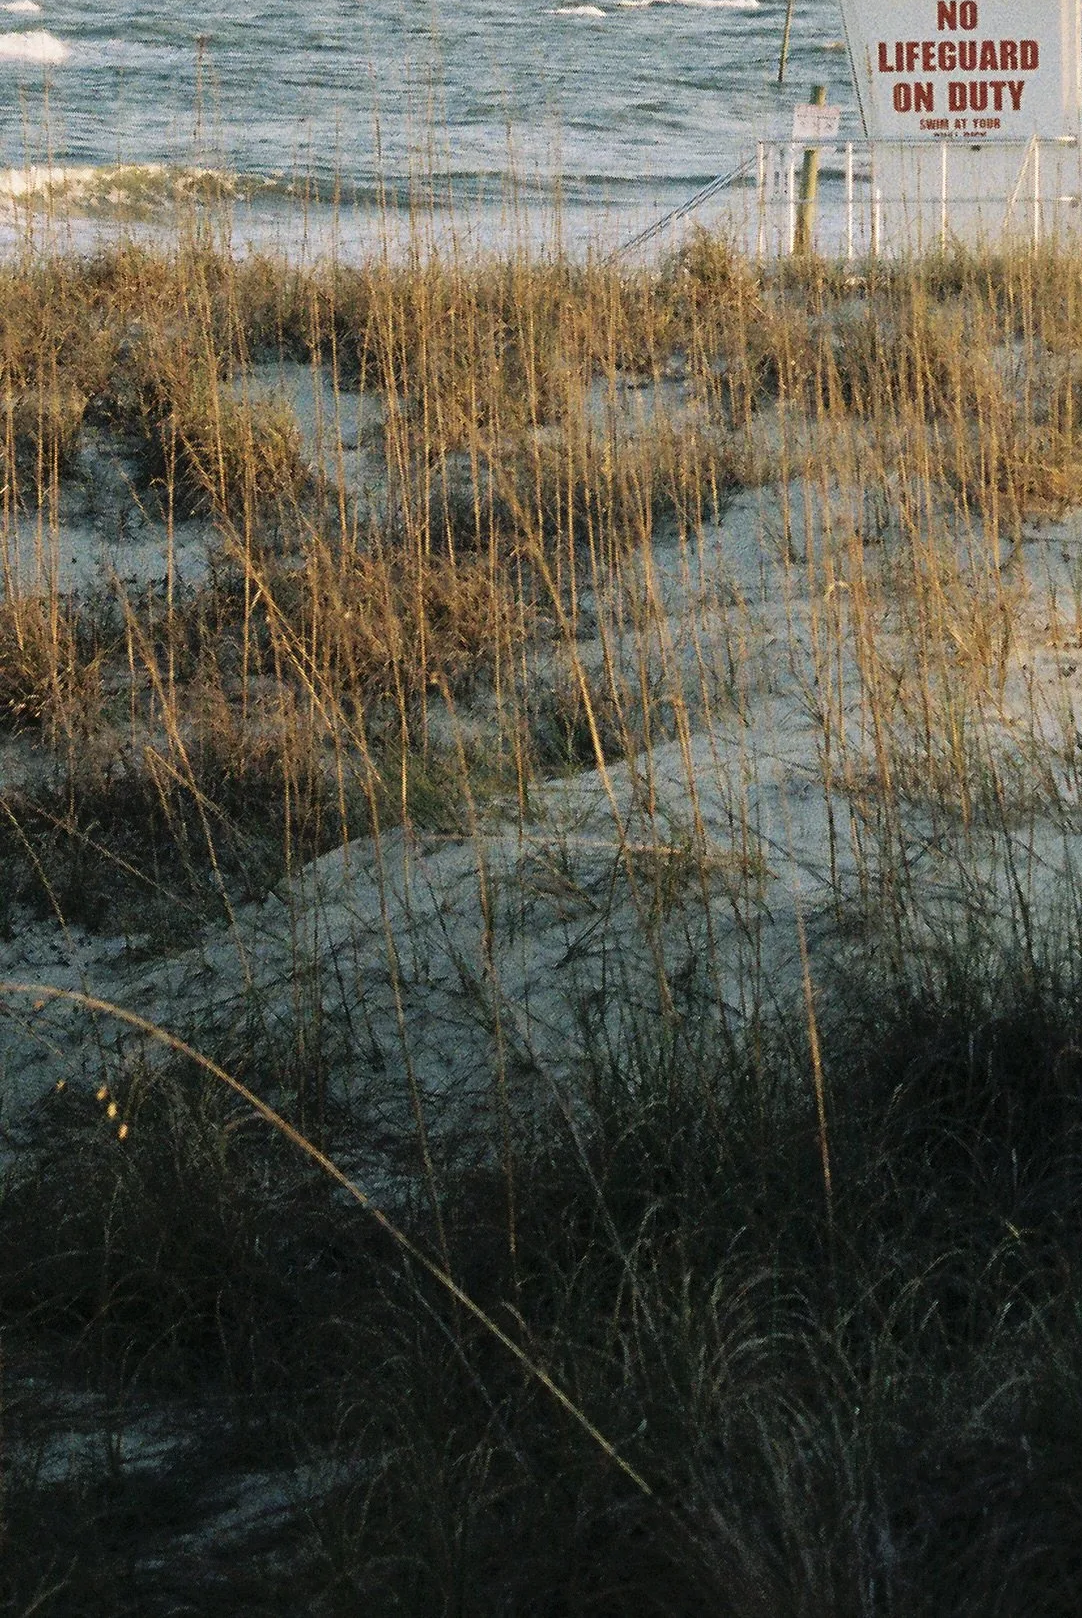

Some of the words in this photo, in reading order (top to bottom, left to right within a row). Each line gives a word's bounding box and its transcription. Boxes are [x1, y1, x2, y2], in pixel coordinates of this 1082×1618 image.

[937, 0, 978, 31] NO
[878, 39, 1040, 73] LIFEGUARD
[893, 81, 934, 113] ON
[948, 80, 1025, 112] DUTY
[954, 118, 968, 129] AT
[972, 117, 1001, 129] YOUR
